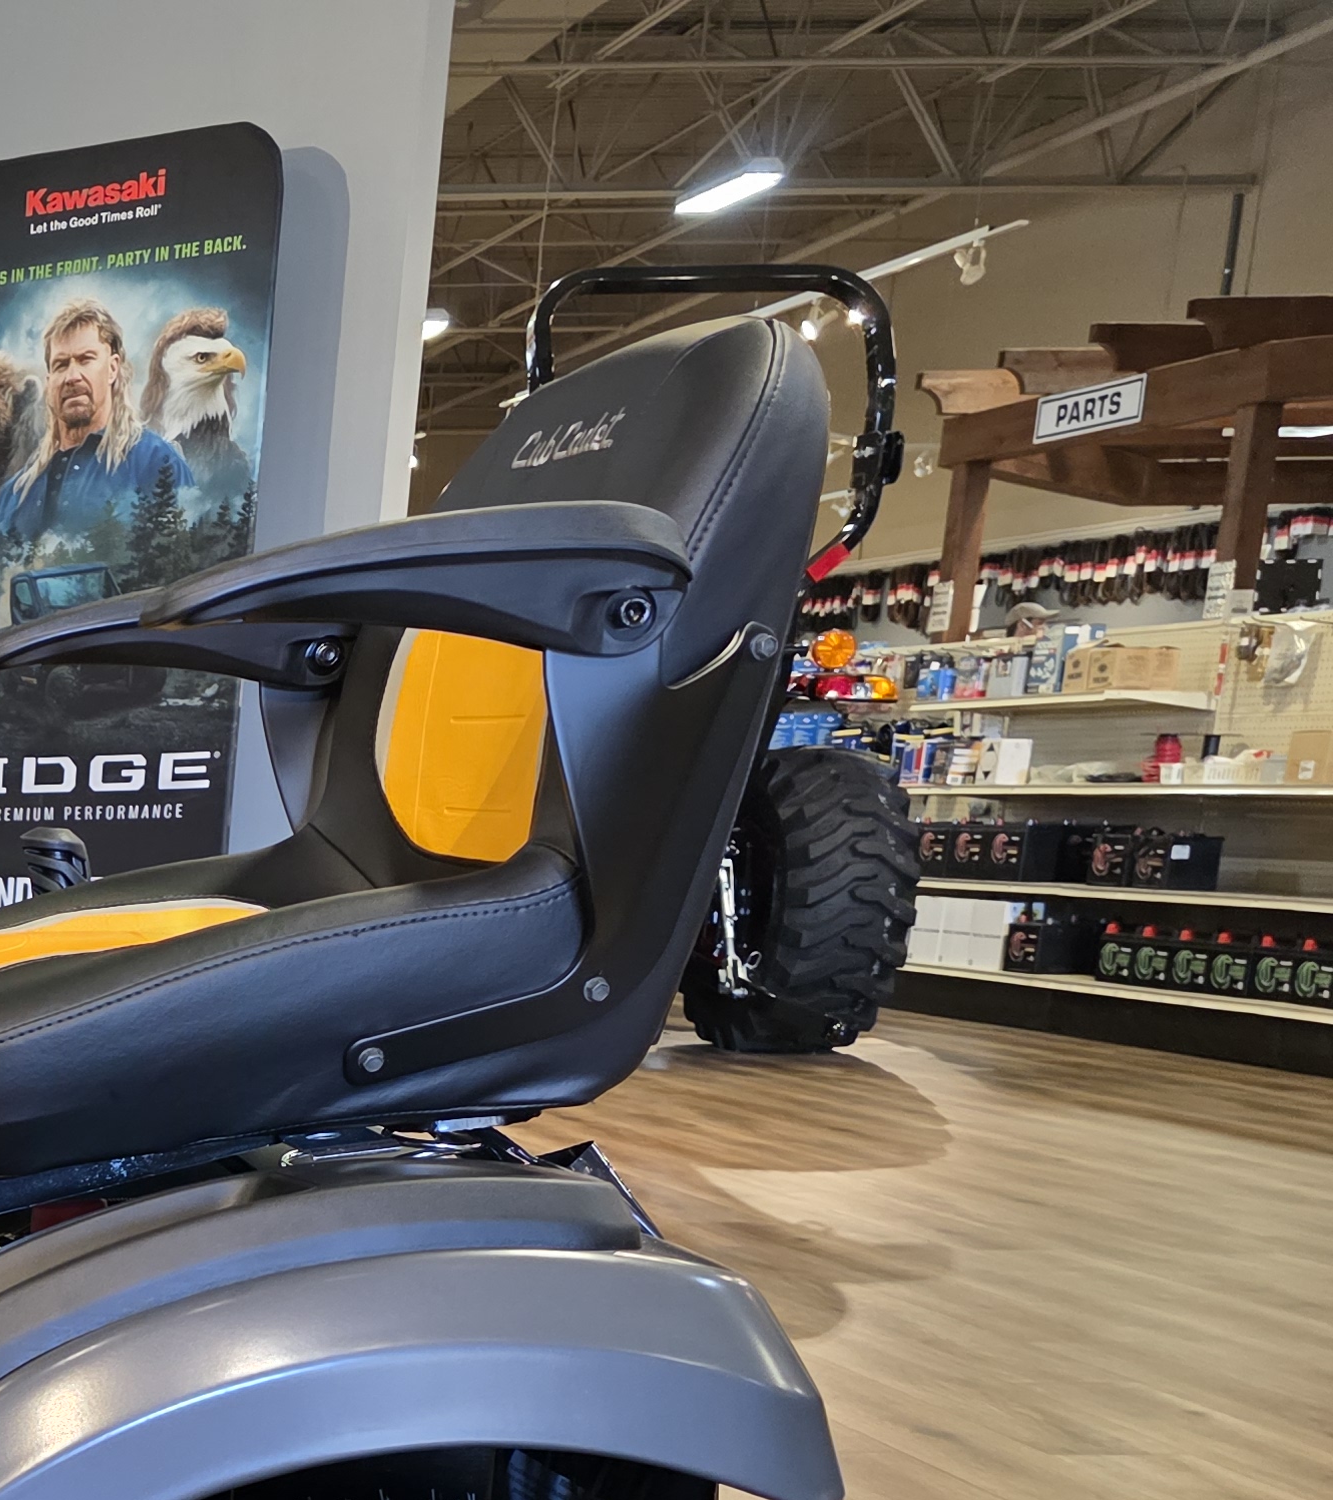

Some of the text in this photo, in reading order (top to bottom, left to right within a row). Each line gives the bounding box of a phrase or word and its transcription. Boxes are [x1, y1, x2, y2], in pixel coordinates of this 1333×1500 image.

[25, 168, 166, 217] Kawasaki
[30, 221, 48, 235] Let
[50, 219, 68, 232] the
[69, 213, 99, 229] Good
[100, 208, 133, 224] Times
[11, 267, 25, 284] IN
[28, 264, 53, 281] THE
[56, 256, 103, 277] FRONT.
[107, 248, 151, 270] PARTY
[155, 245, 169, 262] IN
[174, 241, 199, 260] THE
[204, 235, 247, 255] BACK.
[1055, 390, 1122, 428] PARTS
[511, 424, 564, 469] Cub
[64, 803, 183, 821] PERFORMANCE
